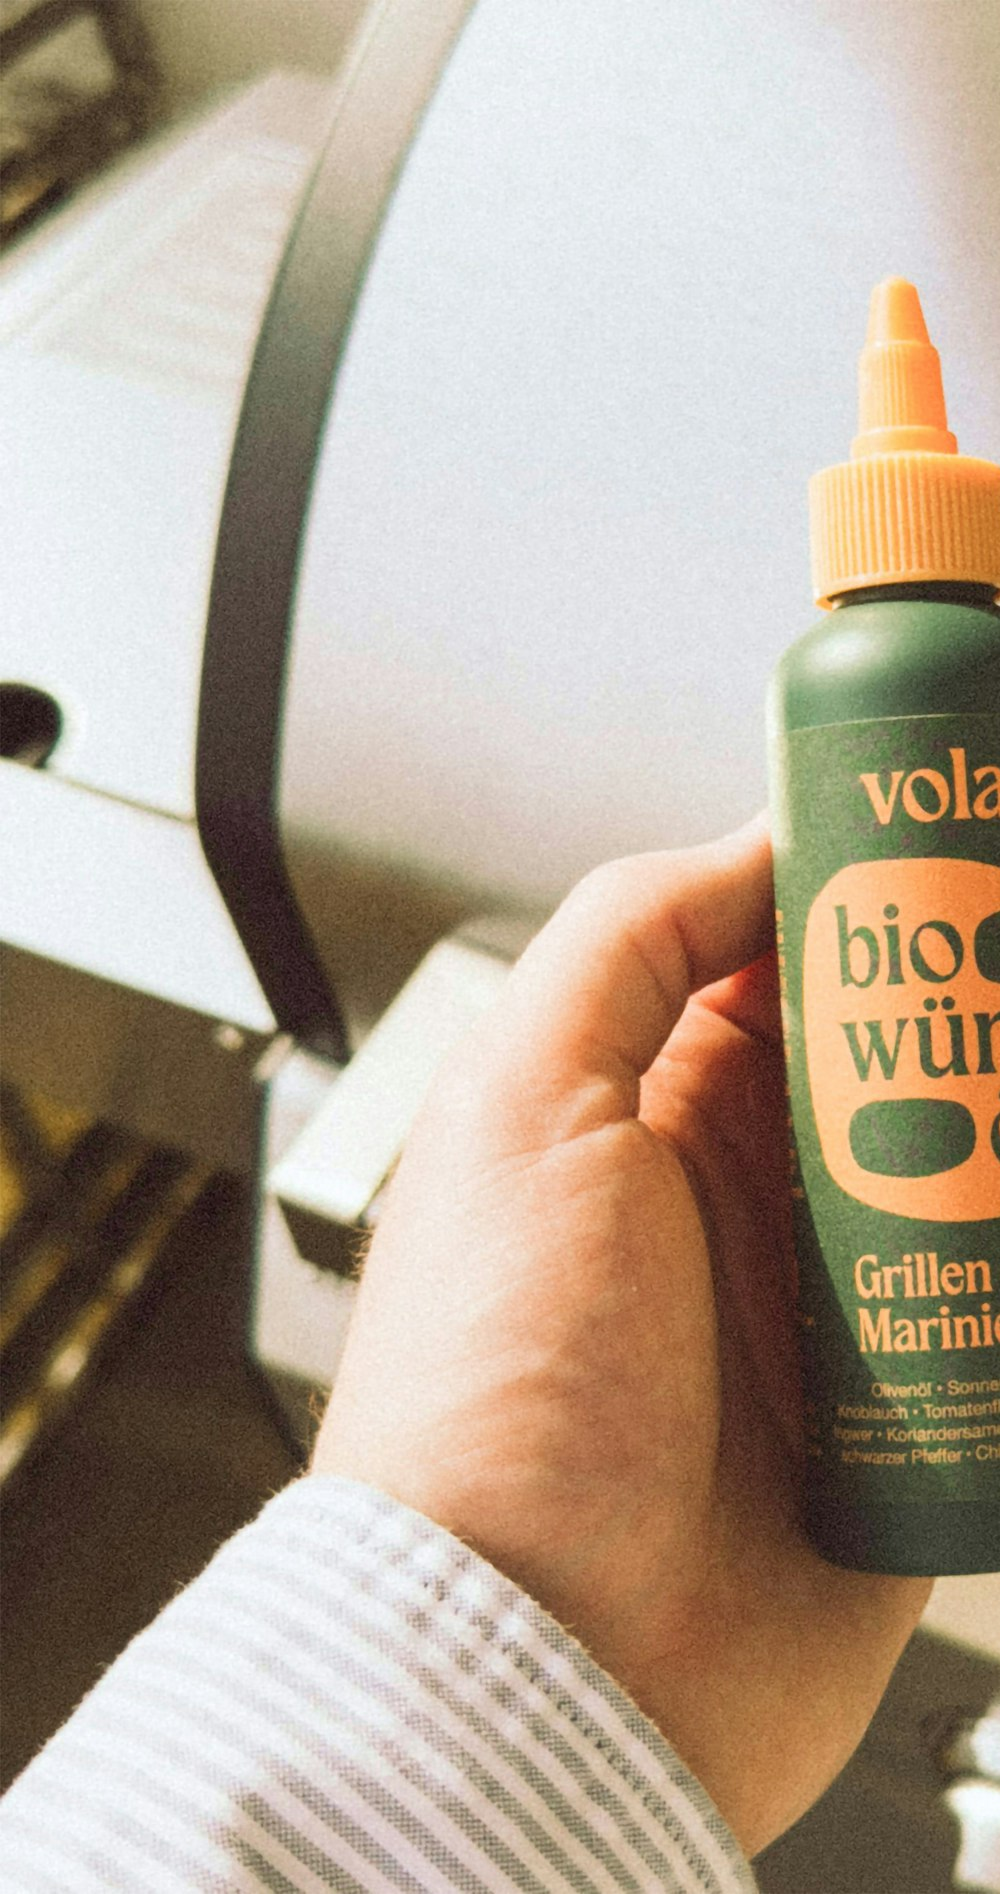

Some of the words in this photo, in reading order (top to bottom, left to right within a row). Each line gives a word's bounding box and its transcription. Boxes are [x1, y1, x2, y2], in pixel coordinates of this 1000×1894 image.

[835, 903, 964, 988] bio
[854, 1252, 993, 1299] Grillen
[871, 1381, 933, 1398] Olivenöl
[836, 1403, 909, 1420] Knoblauch
[911, 1447, 962, 1465] Pfeffer
